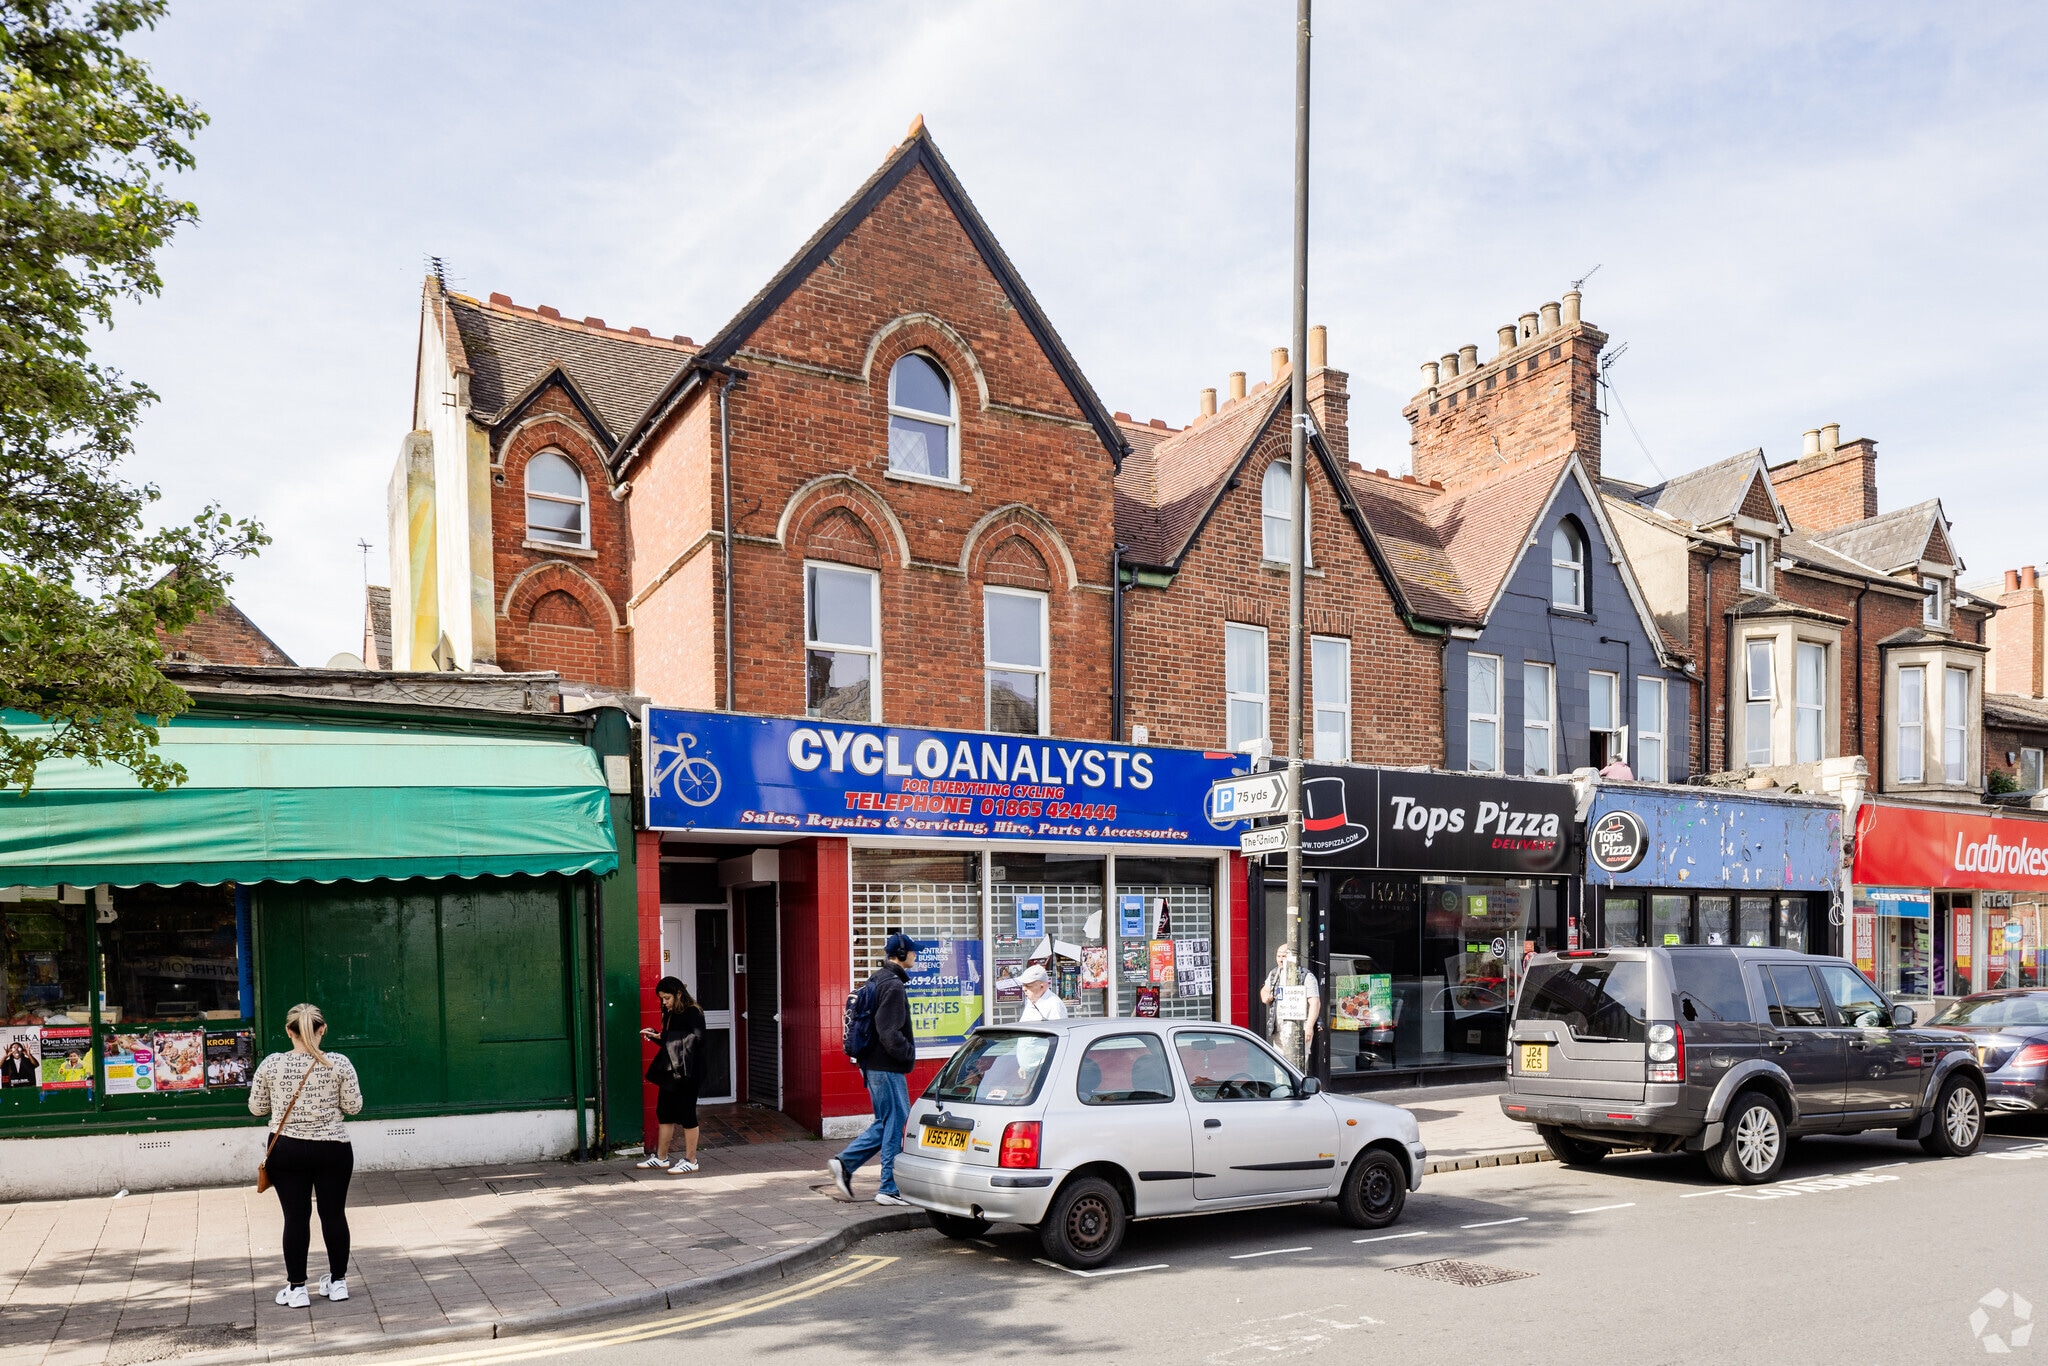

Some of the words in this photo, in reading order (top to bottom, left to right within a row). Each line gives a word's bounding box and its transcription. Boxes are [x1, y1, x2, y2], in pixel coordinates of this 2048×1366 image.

[787, 728, 1154, 790] CYCLOANALYSTS
[901, 779, 928, 792] FOR
[931, 780, 1010, 798] EVERYTHING
[1013, 784, 1064, 800] CYCLING
[844, 792, 972, 814] TELEPHONE
[980, 798, 1041, 817] 01865
[1046, 801, 1117, 821] 424444
[1220, 790, 1232, 811] P
[1237, 792, 1249, 803] 75
[1250, 789, 1268, 803] yds
[740, 810, 800, 827] Sales,
[806, 813, 881, 829] Repairs
[885, 817, 900, 828] &
[903, 817, 988, 835] Servicing,
[993, 821, 1034, 837] Hire,
[1037, 823, 1081, 837] Parts
[1085, 825, 1098, 836] &
[1100, 826, 1188, 840] Accessories
[1390, 796, 1465, 847] Tops
[1474, 801, 1560, 838] Pizza
[1244, 837, 1257, 847] The
[1302, 833, 1359, 849] WW.TOPSPIZZA.COM
[1491, 838, 1555, 850] DELIVERY
[1597, 831, 1624, 845] Tops
[1601, 843, 1632, 857] Pizza
[1954, 832, 2048, 877] Ladbrokes
[1956, 914, 1971, 936] BIG
[925, 976, 959, 985] 241381
[915, 1017, 939, 1030] LET
[13, 1034, 39, 1042] HEKA
[42, 1038, 61, 1046] Open
[206, 1038, 235, 1047] KROKE
[1526, 1047, 1542, 1057] J24
[1526, 1059, 1542, 1069] XCS
[949, 1132, 967, 1148] KBM
